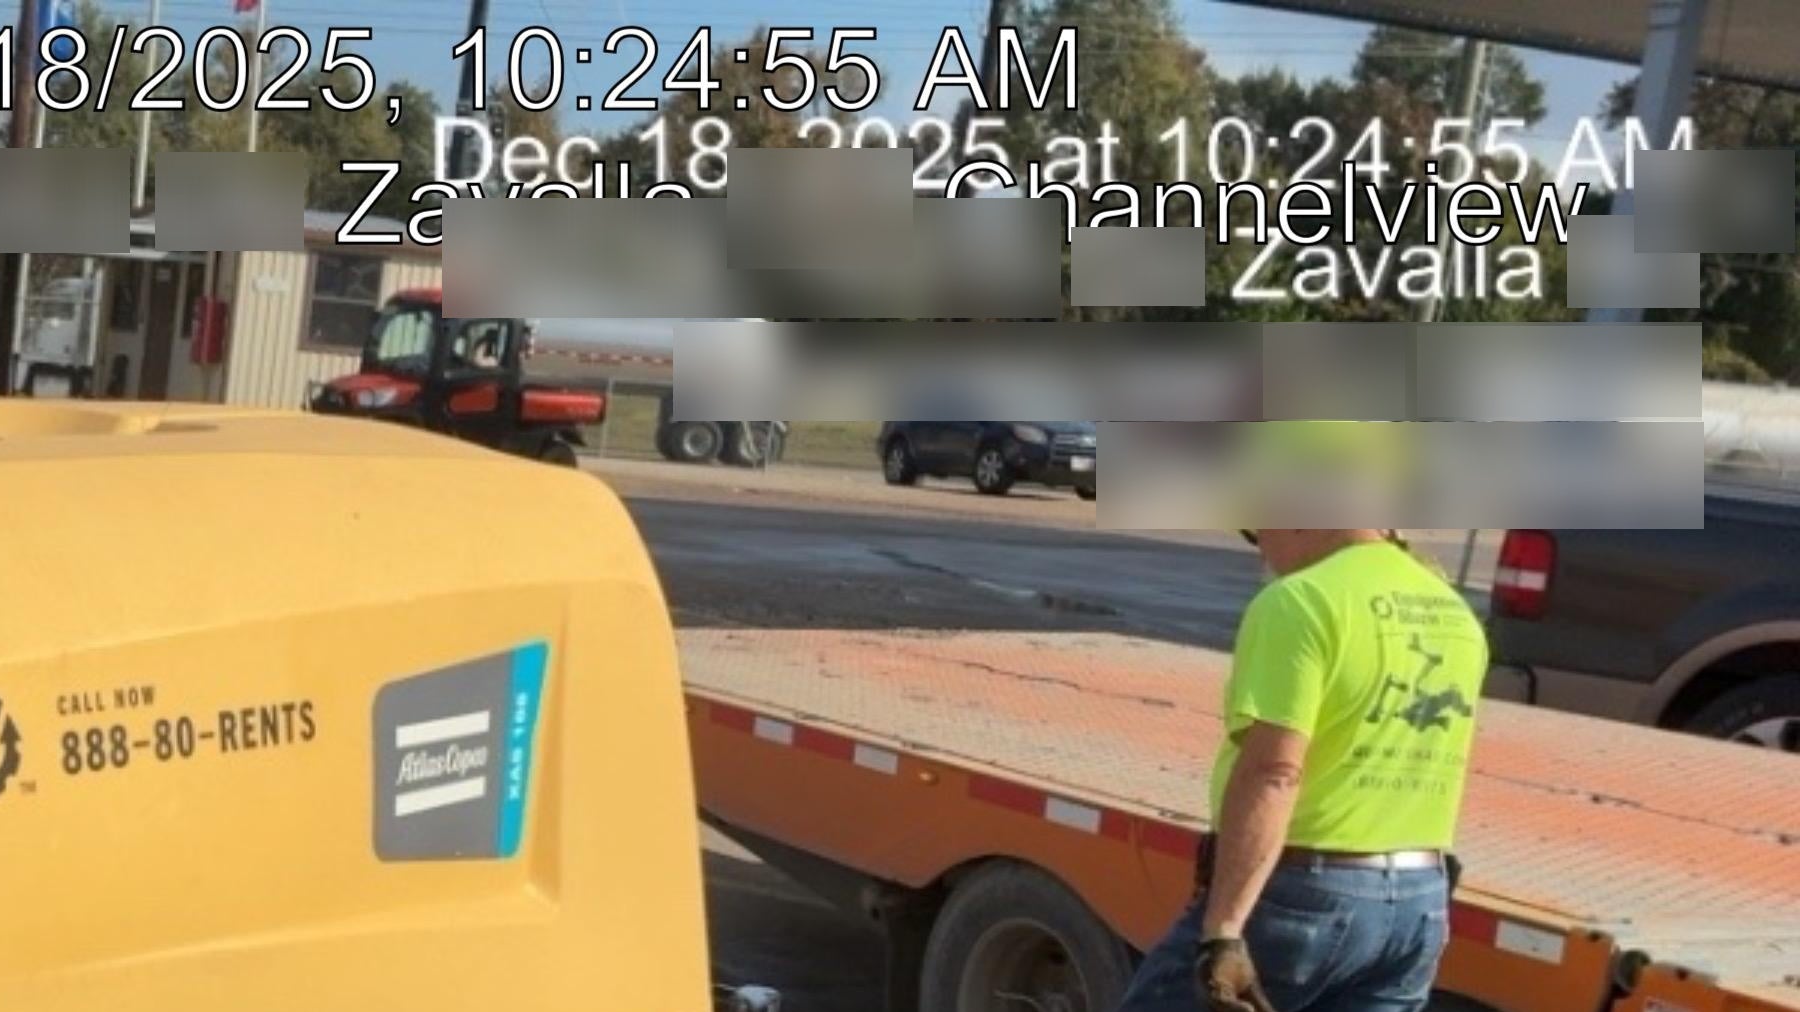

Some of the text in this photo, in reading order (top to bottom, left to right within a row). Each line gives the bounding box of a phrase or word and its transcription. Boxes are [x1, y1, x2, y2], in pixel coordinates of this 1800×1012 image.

[56, 686, 156, 716] CALL NOW
[60, 700, 317, 776] 888-80-RENTS
